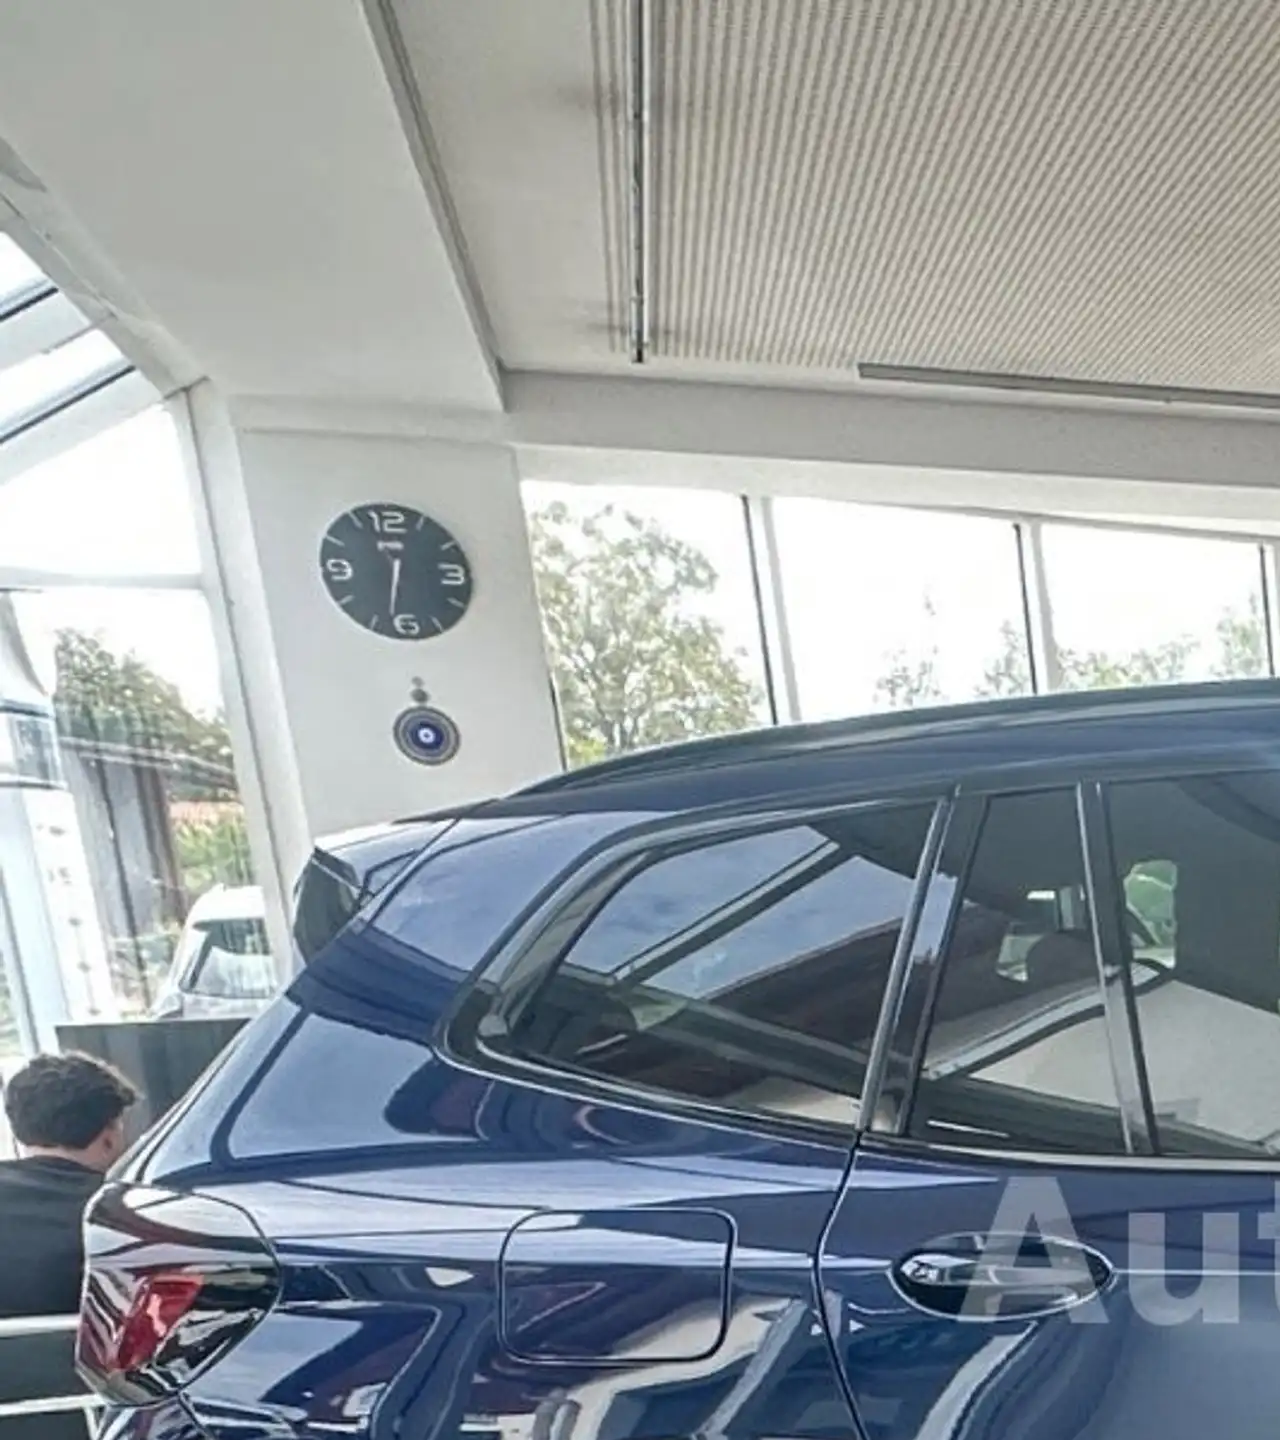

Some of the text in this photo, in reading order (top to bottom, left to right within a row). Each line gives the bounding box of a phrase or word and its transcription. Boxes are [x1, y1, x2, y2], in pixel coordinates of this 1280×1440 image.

[368, 511, 408, 533] 12
[326, 559, 354, 581] 9
[438, 563, 466, 585] 3
[393, 614, 421, 635] 6
